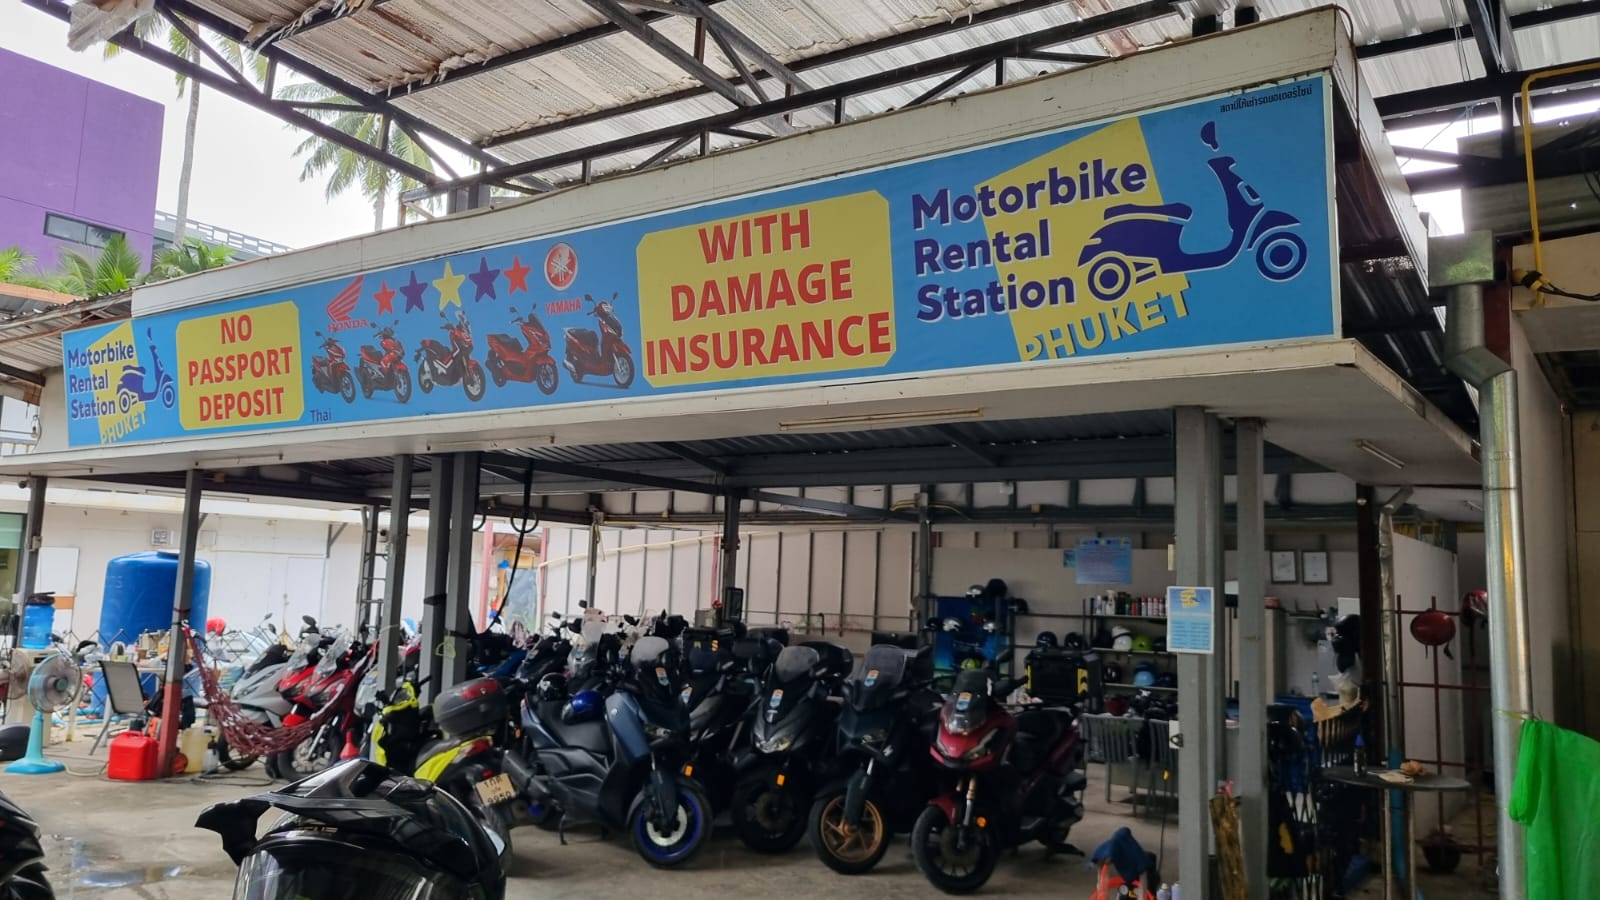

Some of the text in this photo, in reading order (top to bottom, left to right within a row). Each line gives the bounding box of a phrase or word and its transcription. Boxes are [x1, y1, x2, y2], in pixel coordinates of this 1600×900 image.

[912, 158, 1148, 230] Motorbike
[698, 208, 810, 264] WITH
[914, 219, 1051, 276] Rental
[545, 298, 582, 315] YAMAHA
[671, 258, 853, 322] DAMAGE
[917, 273, 1076, 322] Station
[220, 314, 253, 345] NO
[327, 319, 369, 333] HONDA
[1019, 280, 1191, 362] PHUKET
[68, 340, 135, 369] Motorbike
[646, 312, 891, 376] INSURANCE
[70, 372, 109, 393] Rental
[188, 346, 293, 386] PASSPORT
[71, 397, 117, 419] Station
[199, 387, 285, 422] DEPOSIT
[310, 408, 332, 423] Thai
[101, 408, 148, 445] PHUKET
